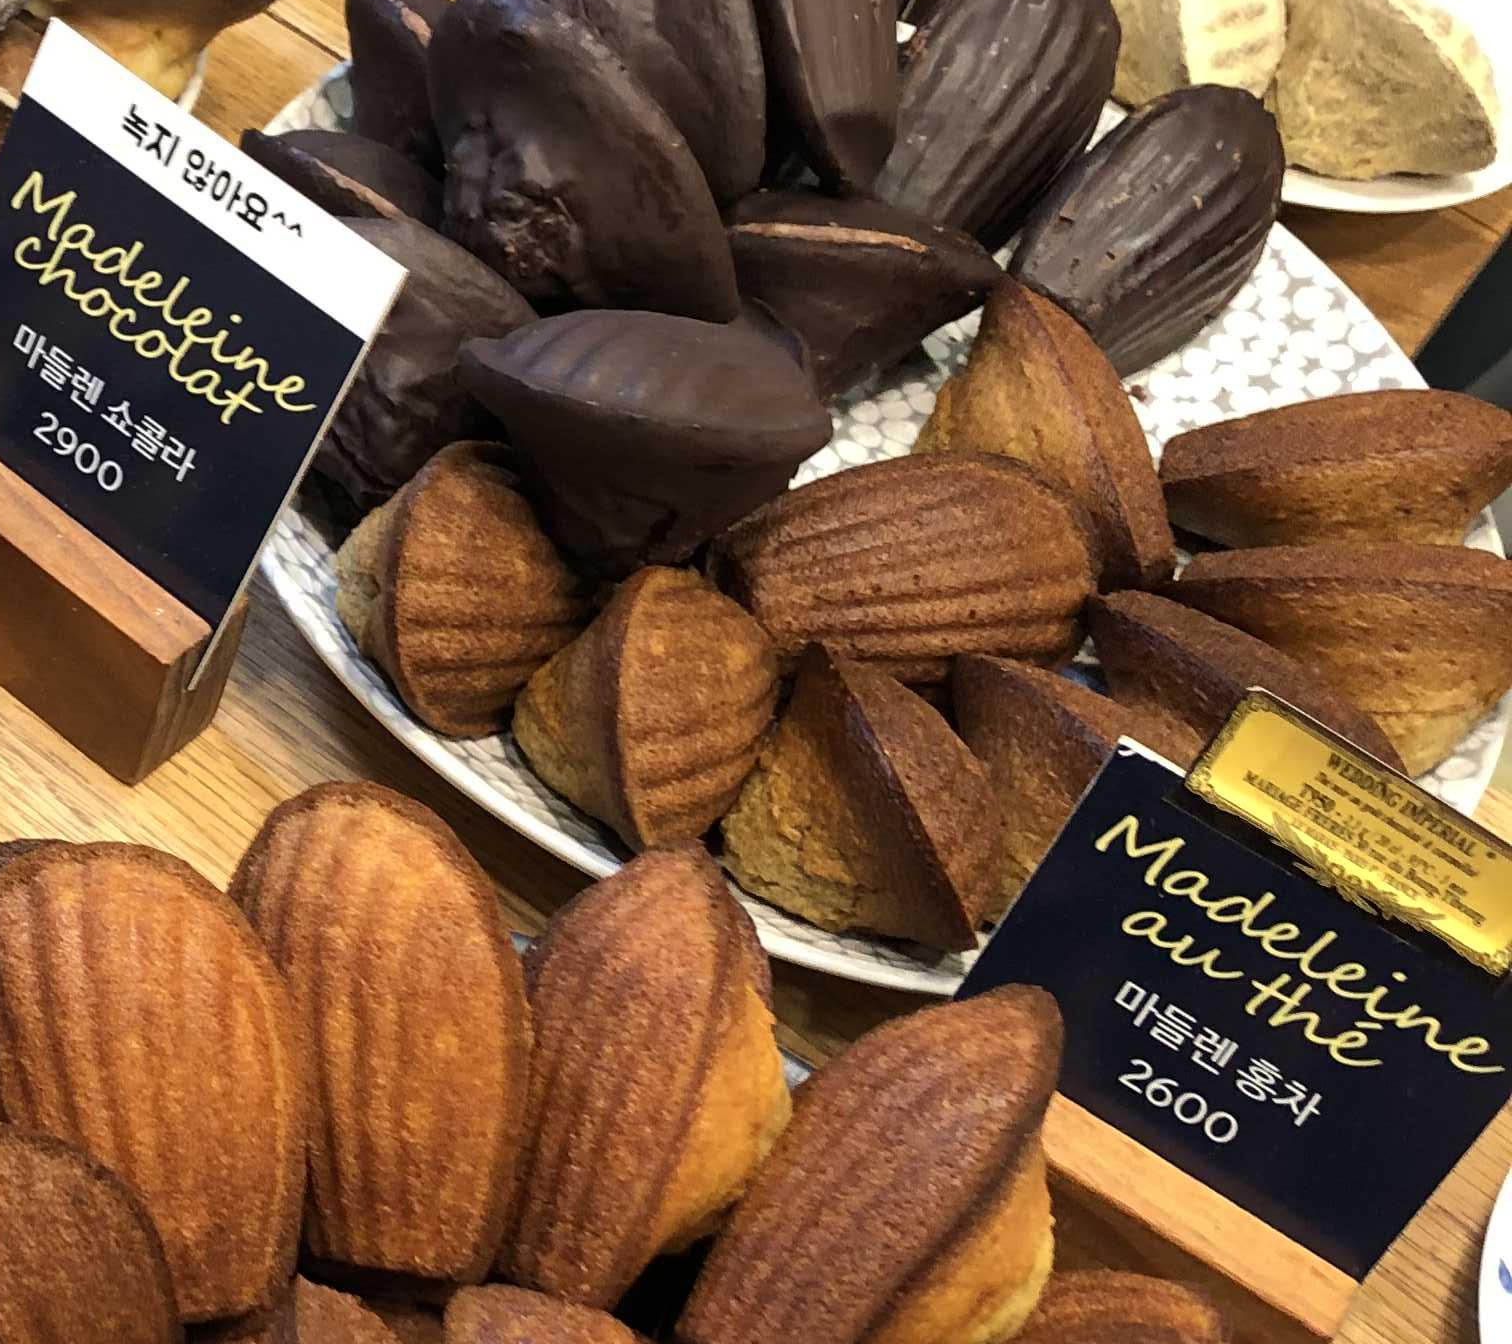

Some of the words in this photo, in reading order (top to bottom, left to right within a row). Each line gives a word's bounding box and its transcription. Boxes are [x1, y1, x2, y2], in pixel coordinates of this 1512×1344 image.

[121, 103, 183, 168] 녹지
[9, 170, 317, 413] Madeleine
[13, 235, 263, 425] chocolat
[11, 323, 104, 414] 마들렌
[100, 398, 197, 482] 쇼콜라
[32, 410, 123, 493] 2900
[1092, 814, 1505, 1074] Madeleine
[1120, 909, 1244, 980] au
[1241, 973, 1382, 1067] thé
[1113, 979, 1239, 1076] 마들렌
[1234, 1054, 1324, 1128] 홍차
[1117, 1058, 1240, 1144] 2600
